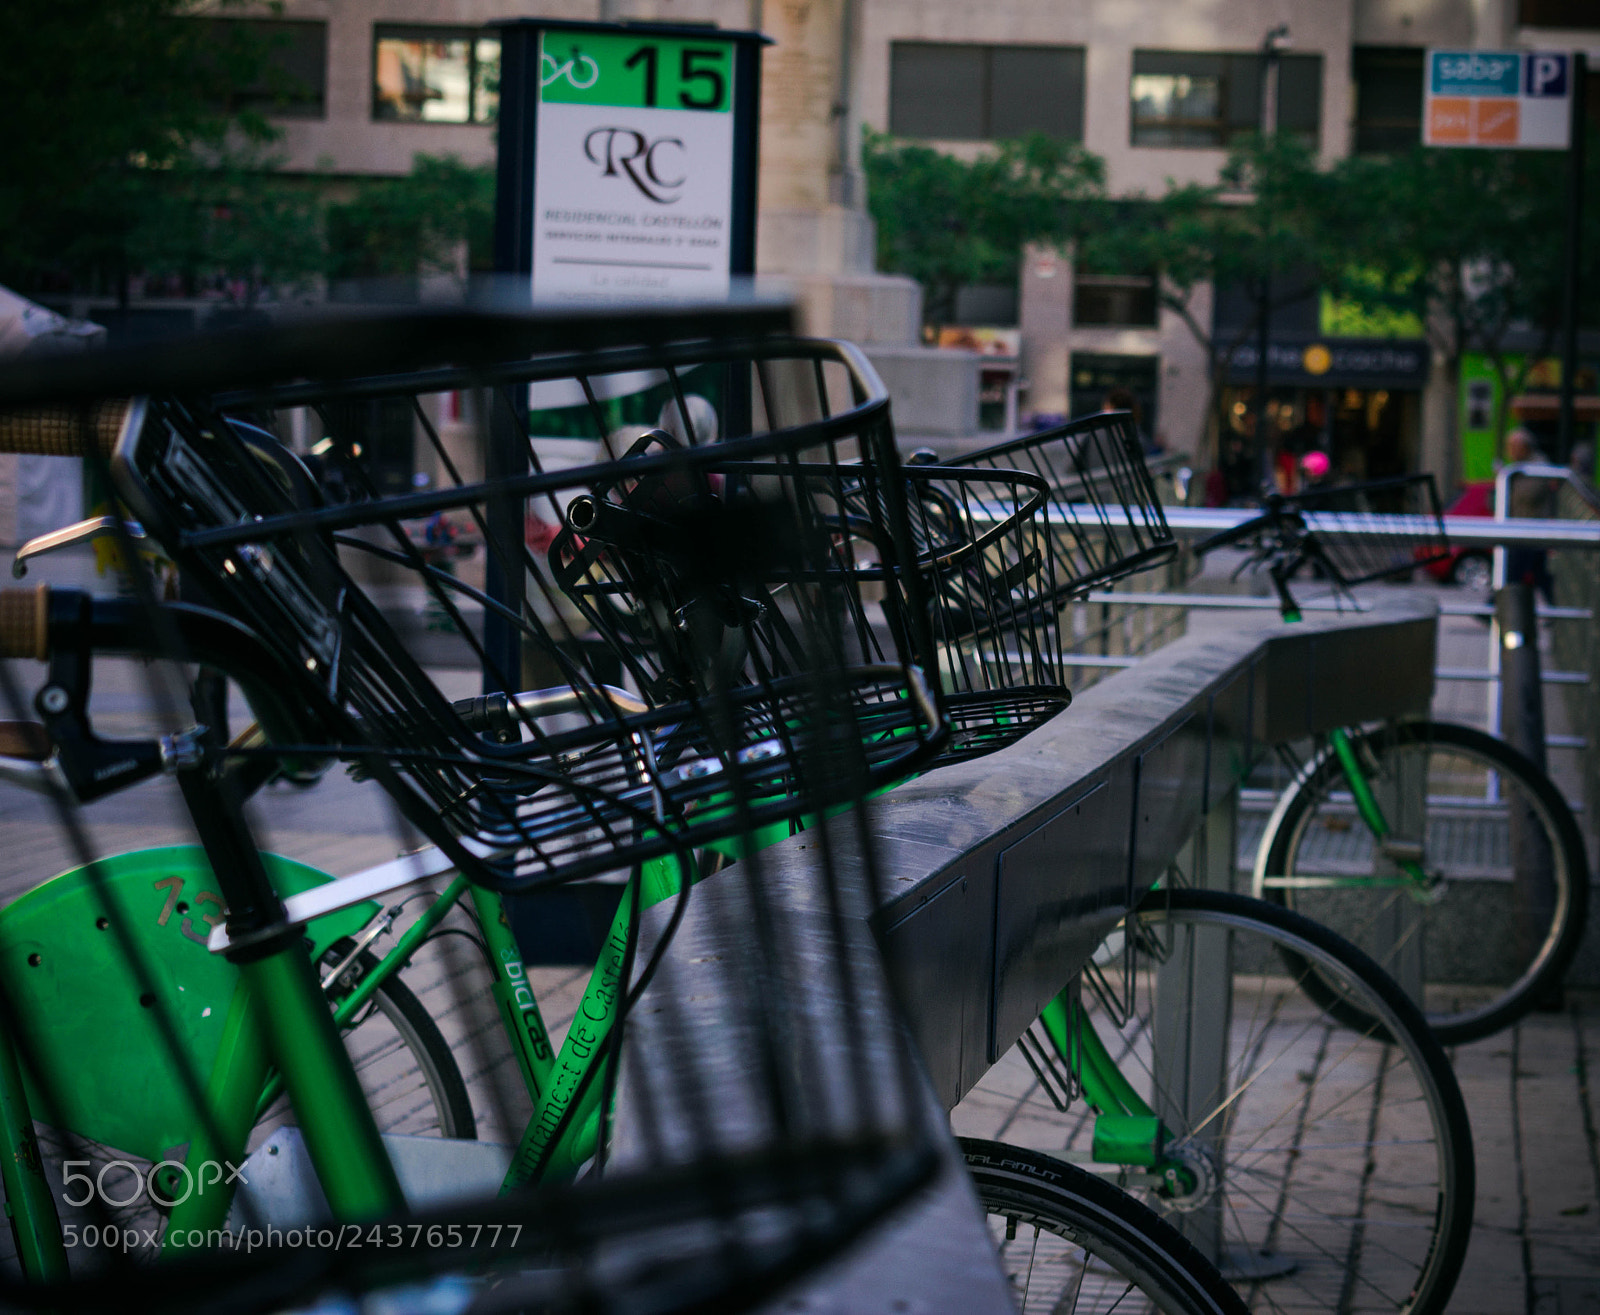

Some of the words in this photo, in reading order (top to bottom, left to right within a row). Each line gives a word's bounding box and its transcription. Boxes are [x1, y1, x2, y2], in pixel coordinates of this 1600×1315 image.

[624, 45, 726, 110] 15
[1532, 58, 1560, 95] P
[583, 125, 687, 205] RC
[544, 209, 638, 227] RESIDENCIAL
[505, 1061, 582, 1189] untament
[569, 1026, 597, 1058] de
